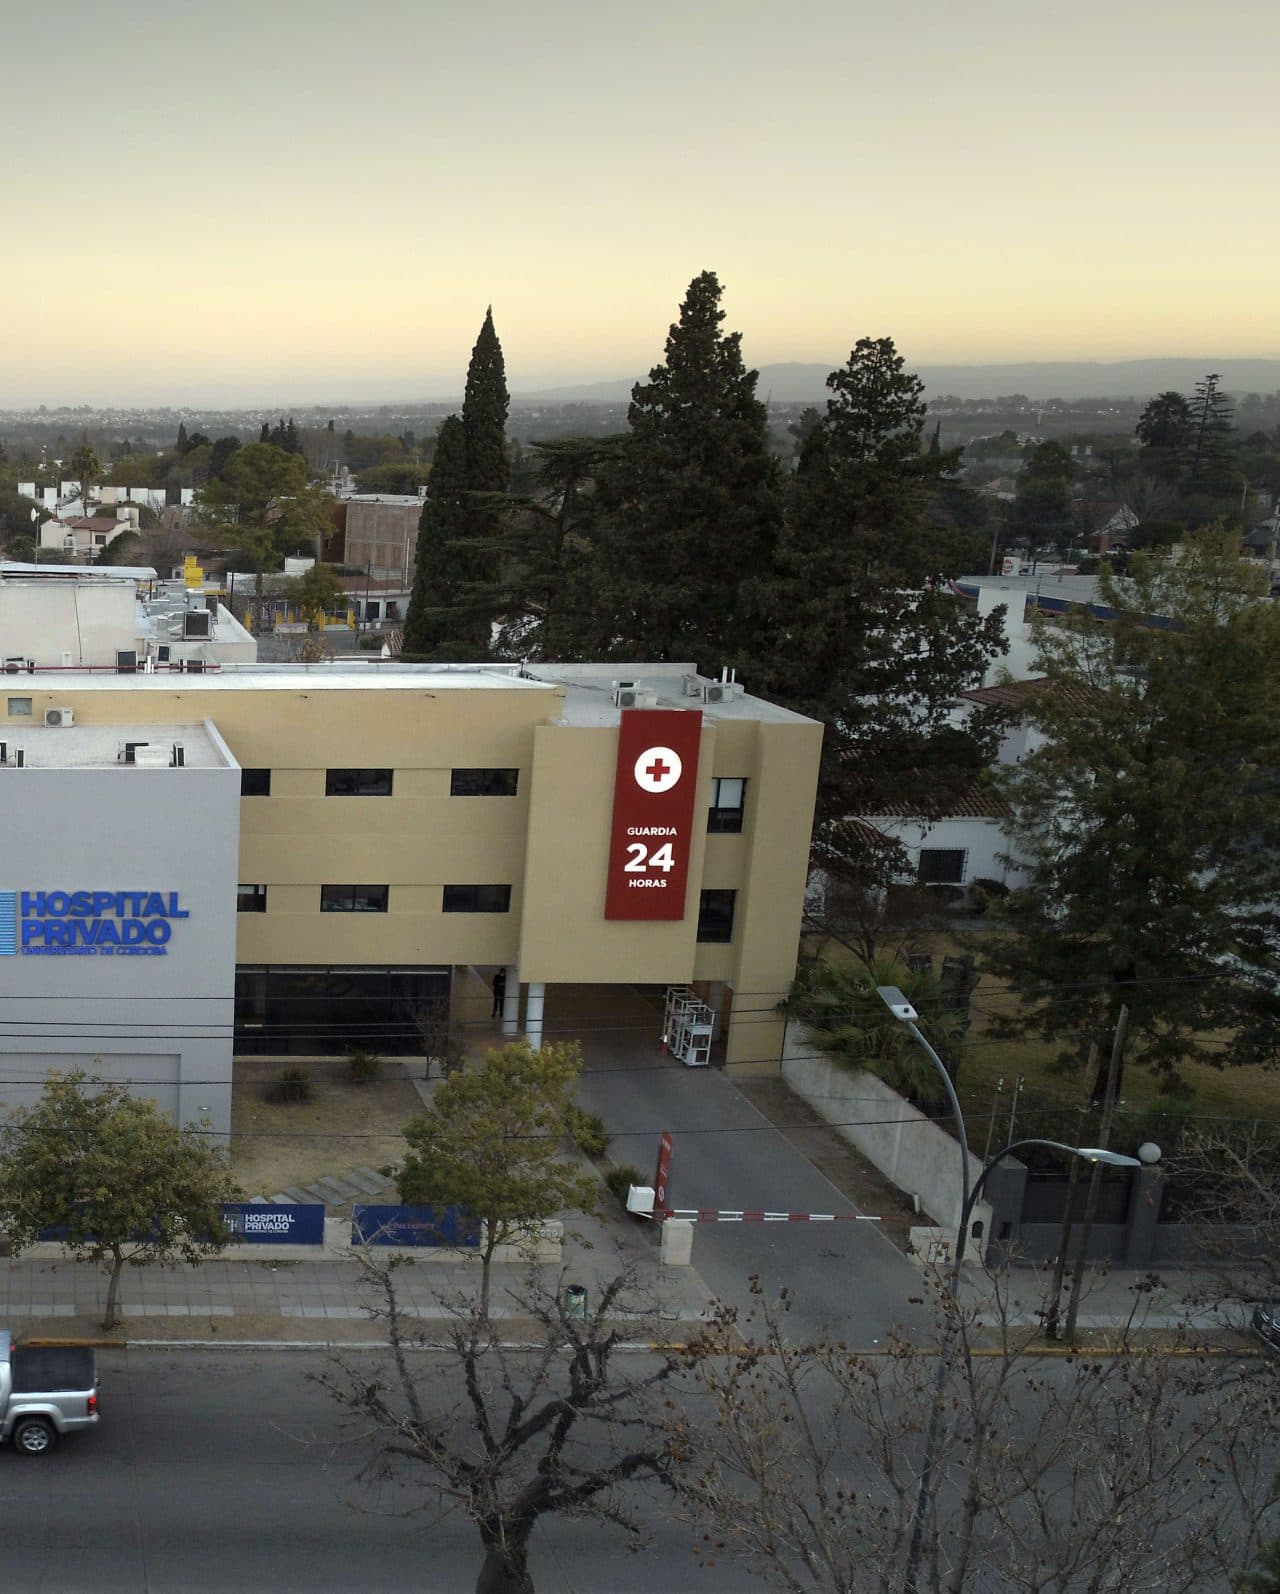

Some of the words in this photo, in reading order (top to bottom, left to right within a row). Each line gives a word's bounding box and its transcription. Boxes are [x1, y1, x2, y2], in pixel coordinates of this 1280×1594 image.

[627, 827, 677, 836] GUARDIA
[624, 843, 675, 872] 24
[628, 879, 667, 888] HORAS
[21, 890, 190, 918] HOSPITAL
[21, 918, 172, 945] PRIVADO
[245, 1214, 295, 1223] HOSPITAL
[245, 1222, 290, 1231] PRIVADO
